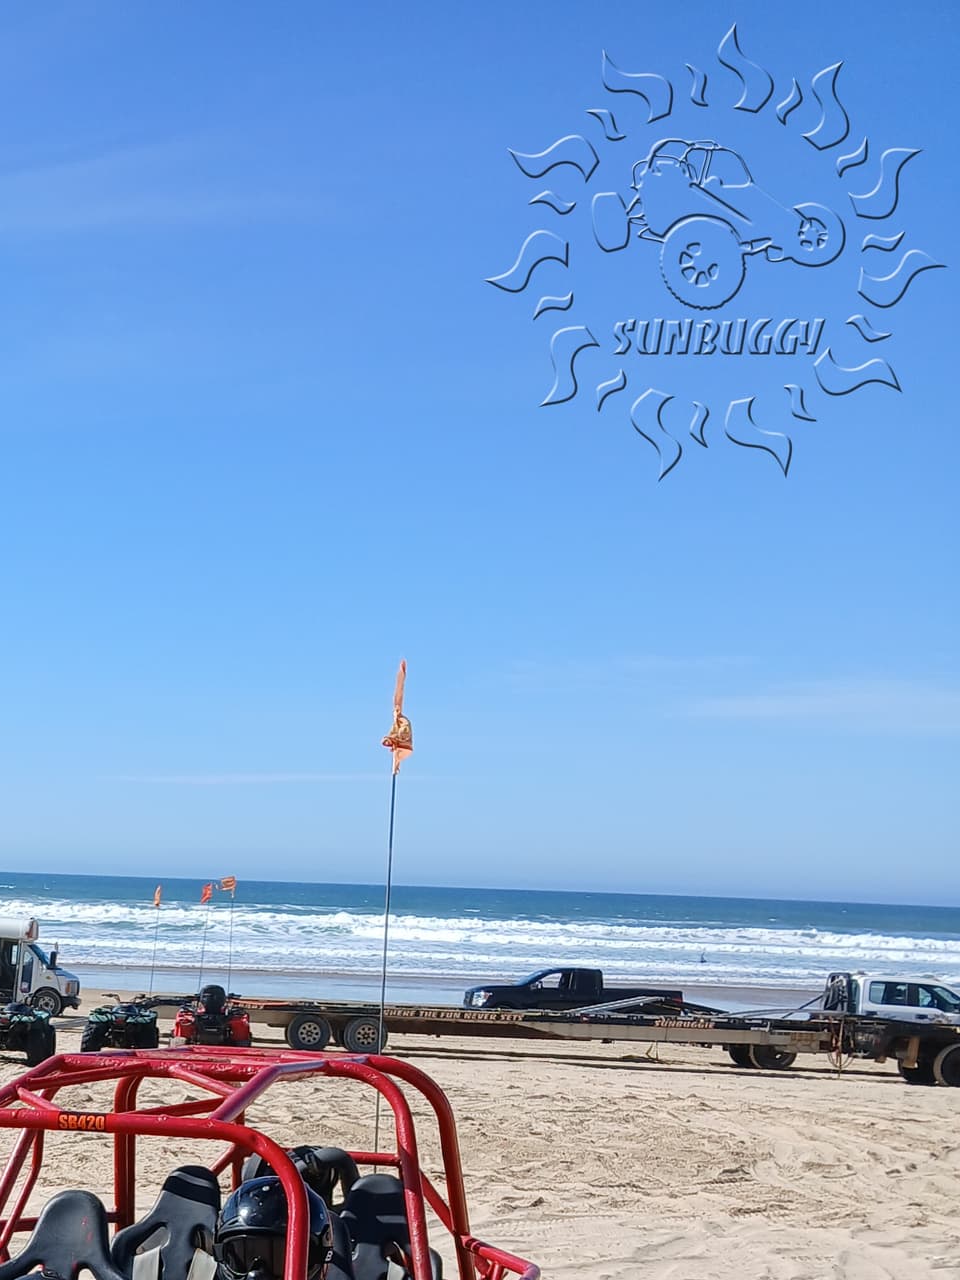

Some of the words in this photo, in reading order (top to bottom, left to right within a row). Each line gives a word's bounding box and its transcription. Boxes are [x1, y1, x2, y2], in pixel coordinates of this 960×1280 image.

[419, 1010, 437, 1019] THE
[440, 1011, 461, 1019] FUN
[464, 1012, 497, 1021] NEVER
[58, 1114, 106, 1131] SB420
